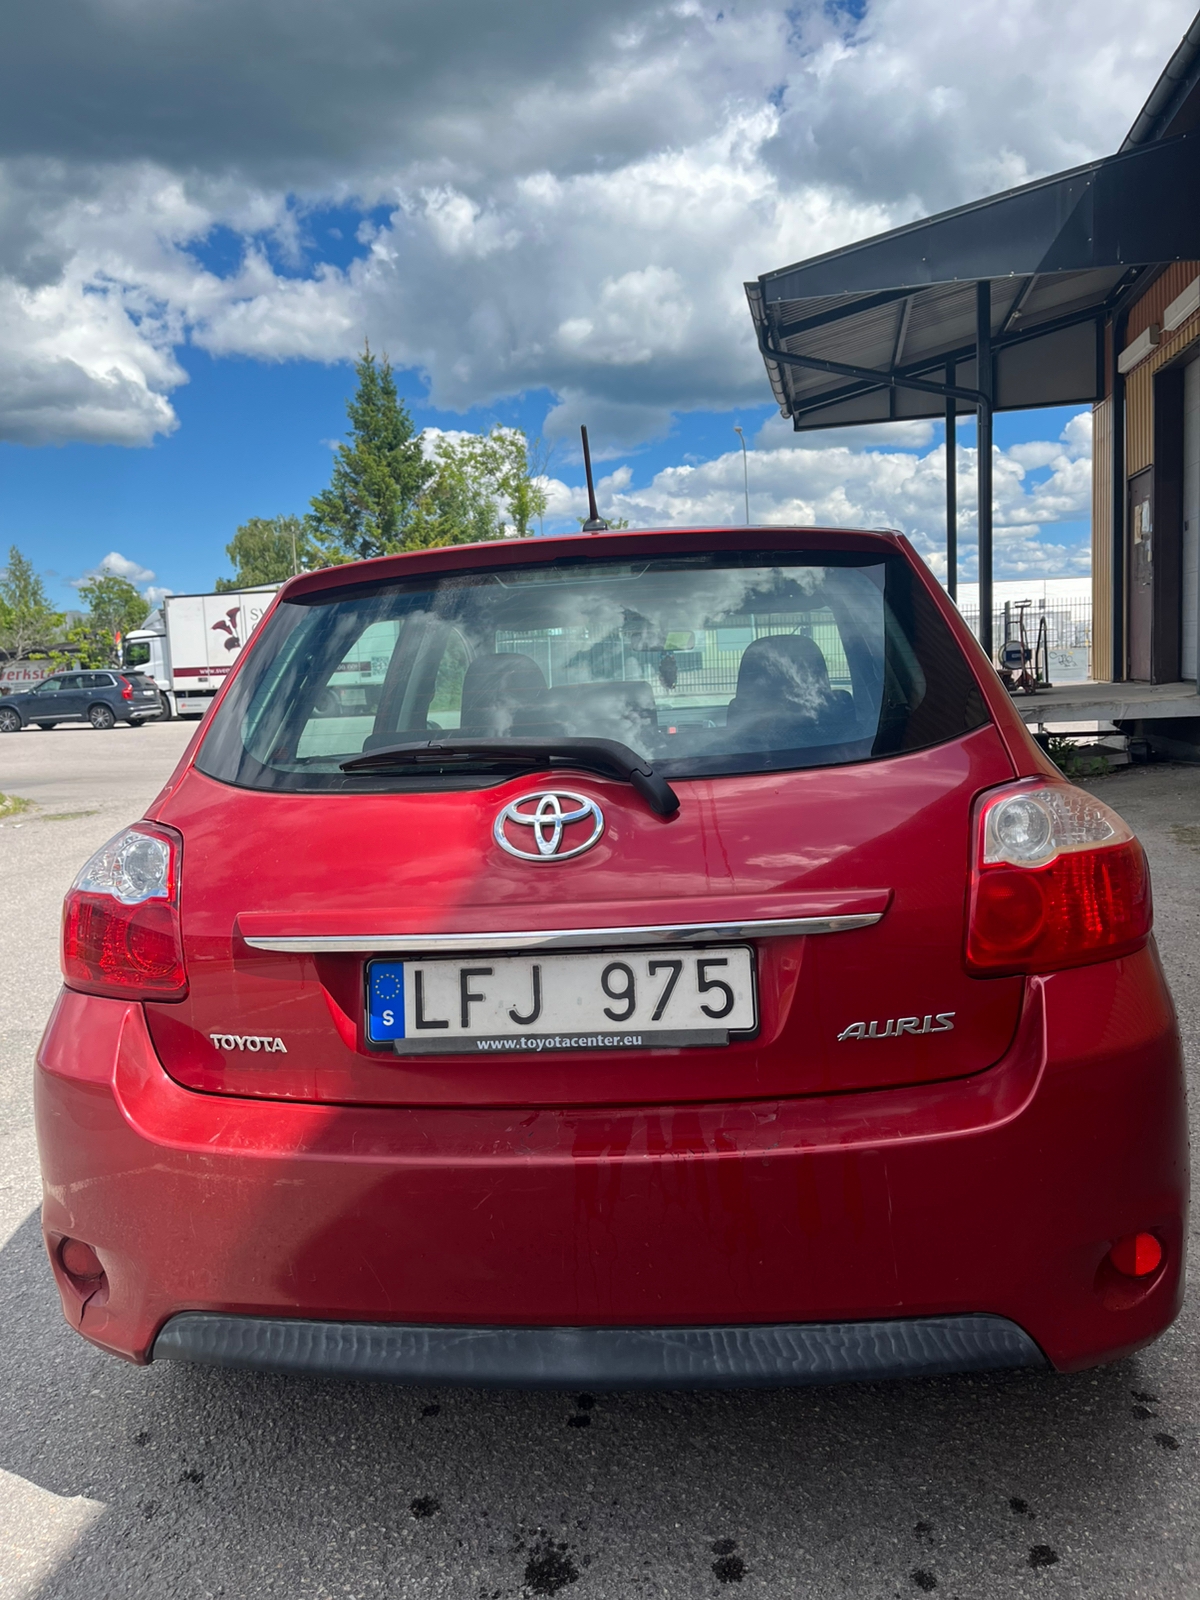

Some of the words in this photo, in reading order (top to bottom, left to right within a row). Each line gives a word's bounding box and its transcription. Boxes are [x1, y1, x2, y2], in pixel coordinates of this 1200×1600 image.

[414, 965, 543, 1029] LFJ
[601, 958, 735, 1022] 975
[382, 1010, 395, 1026] S
[837, 1012, 956, 1041] AURIS
[209, 1033, 288, 1053] TOYOTA
[476, 1035, 642, 1052] www.toyotacenter.eu
